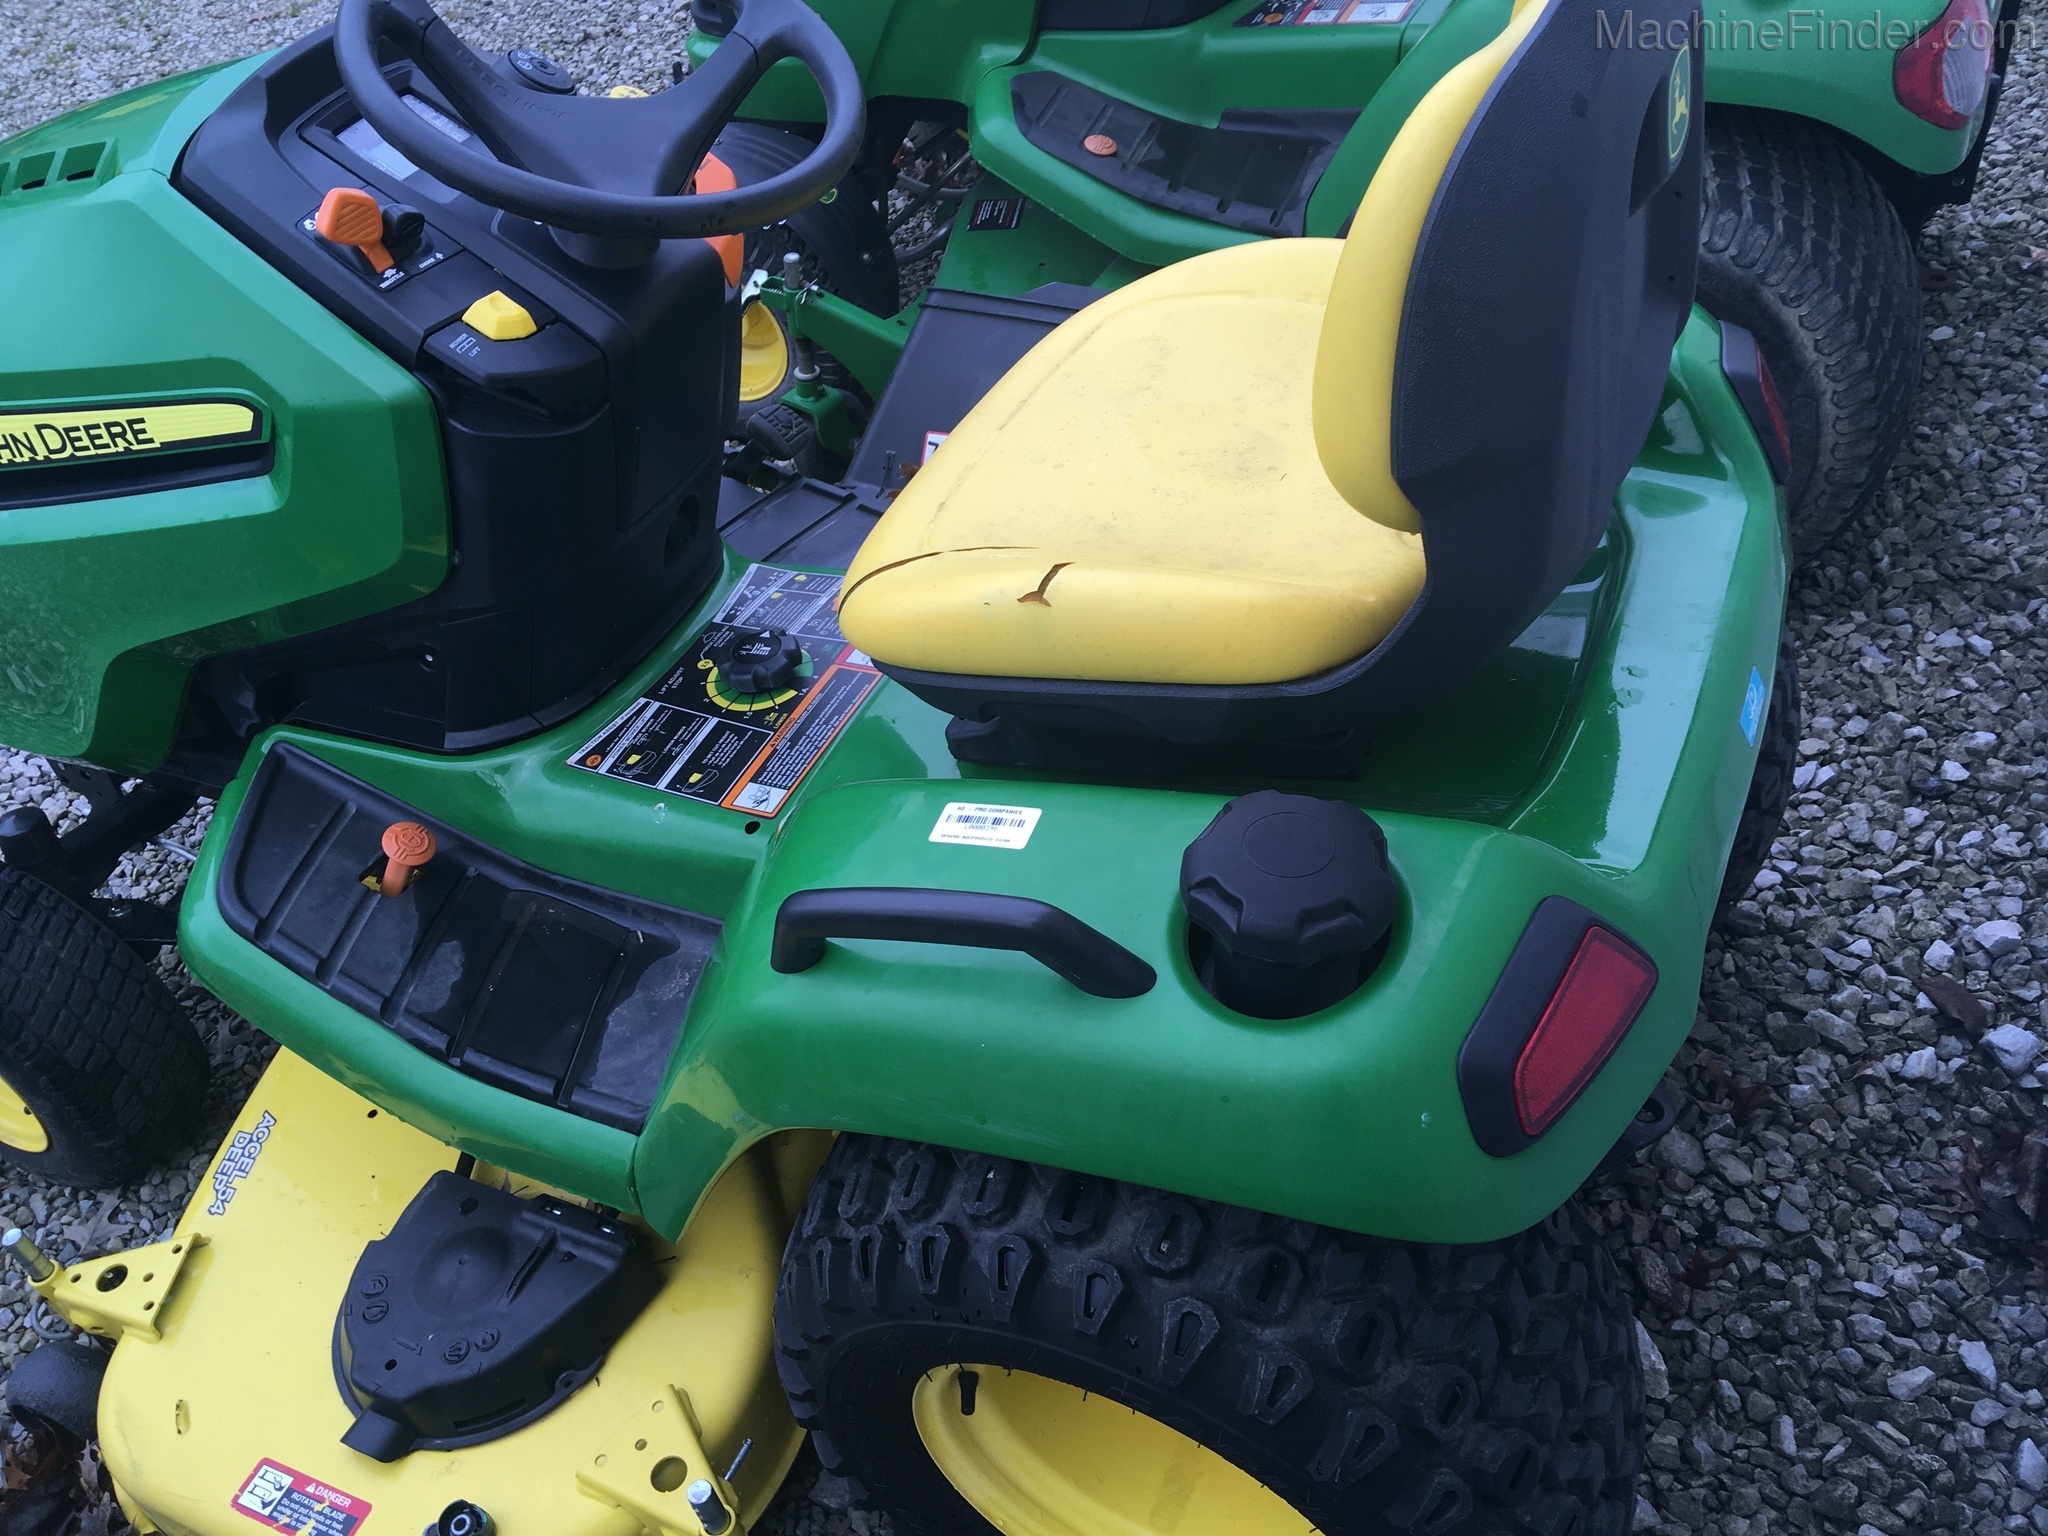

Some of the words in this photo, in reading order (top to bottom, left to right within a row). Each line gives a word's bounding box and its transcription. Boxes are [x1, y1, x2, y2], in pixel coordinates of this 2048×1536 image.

[379, 270, 405, 289] THROTTLE
[34, 417, 154, 457] DEERE
[658, 684, 669, 694] LIFT
[668, 667, 684, 684] ADJUST
[671, 677, 683, 688] STOP
[772, 718, 795, 742] WARNING
[579, 735, 603, 754] TRACTION
[213, 1130, 252, 1190] DEEP
[227, 1110, 277, 1184] ACCEL
[207, 1183, 237, 1216] 54
[291, 1491, 320, 1510] ROTATIN
[323, 1506, 347, 1522] BLADE
[315, 1485, 352, 1508] DANGER
[276, 1505, 294, 1516] under
[281, 1497, 290, 1506] Do
[289, 1502, 300, 1511] not
[298, 1506, 310, 1515] put
[331, 1521, 343, 1531] feet
